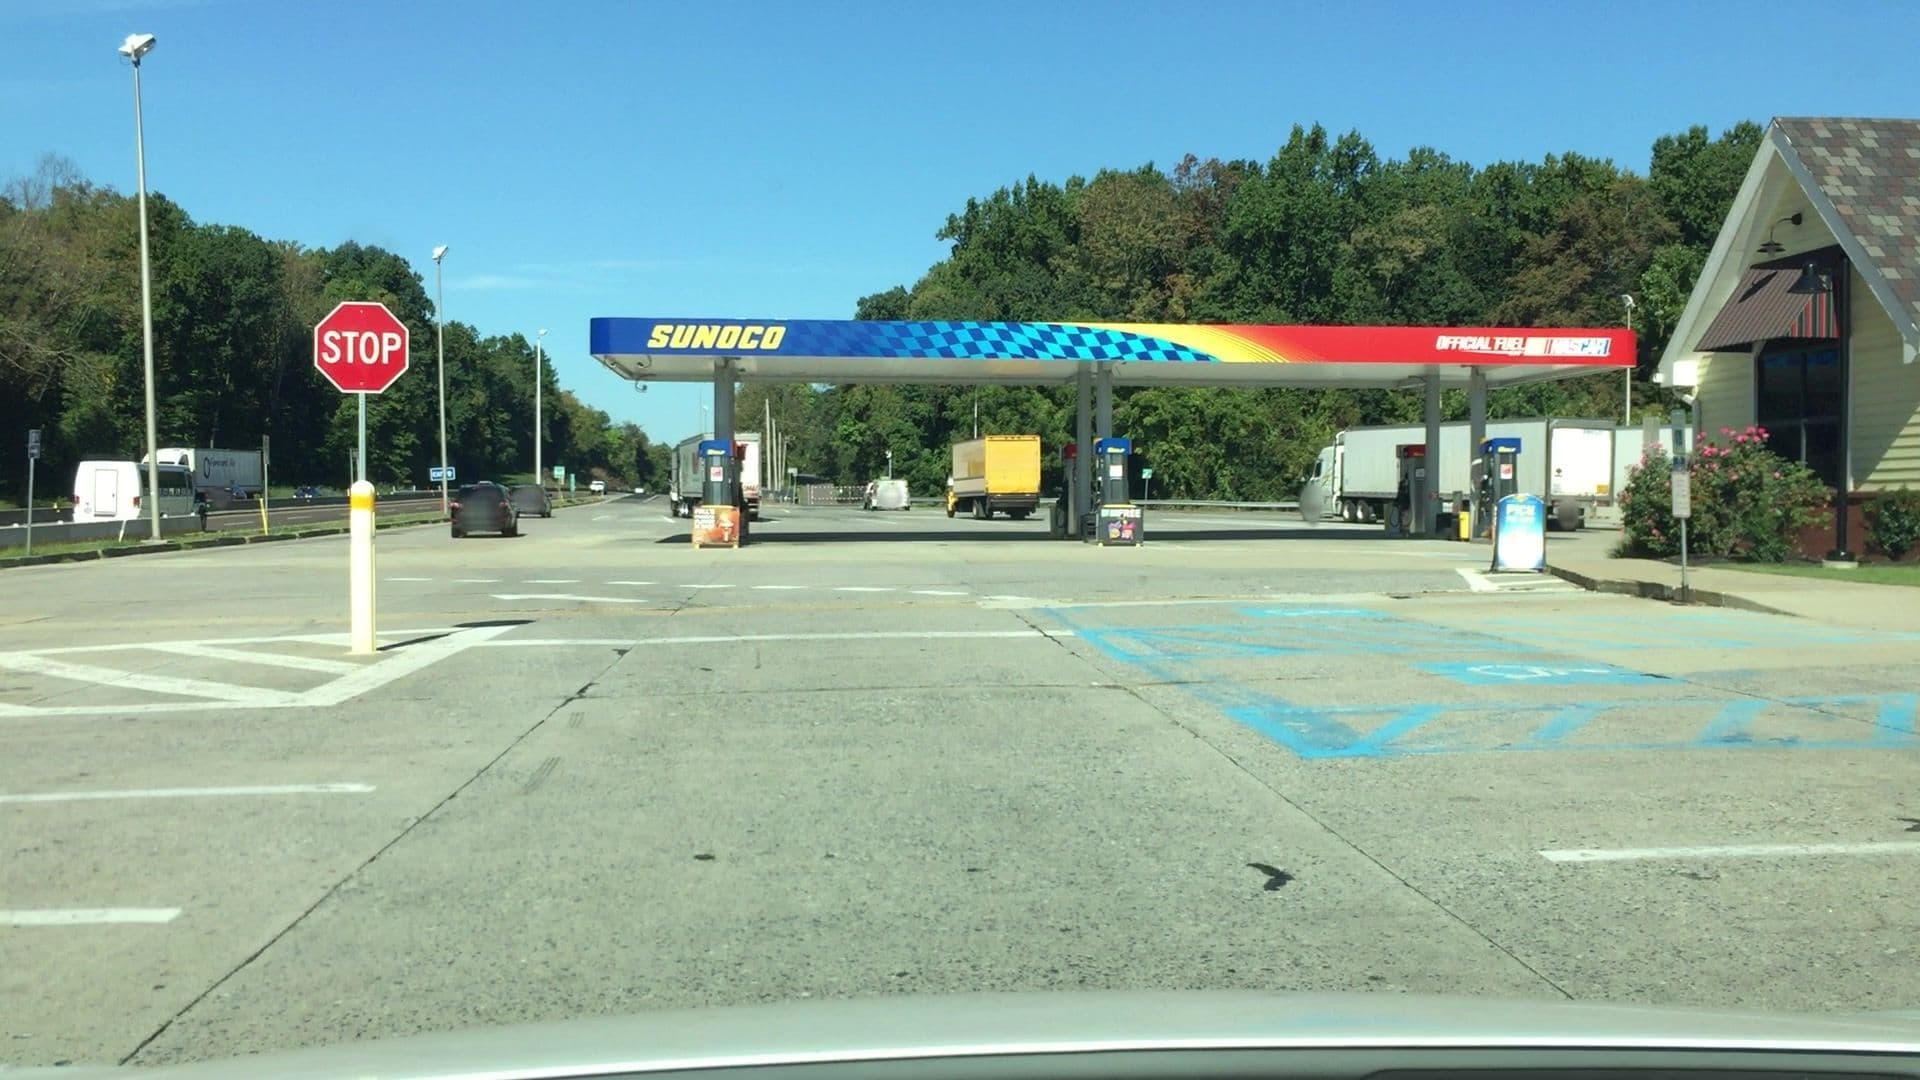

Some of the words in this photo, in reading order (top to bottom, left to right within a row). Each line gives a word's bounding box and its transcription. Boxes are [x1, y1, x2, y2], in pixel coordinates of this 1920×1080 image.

[321, 330, 402, 365] STOP
[647, 324, 787, 350] SUNOCO
[1436, 335, 1492, 351] OFFICIAL
[1494, 336, 1526, 352] FUEL
[1549, 338, 1611, 356] NASCAR
